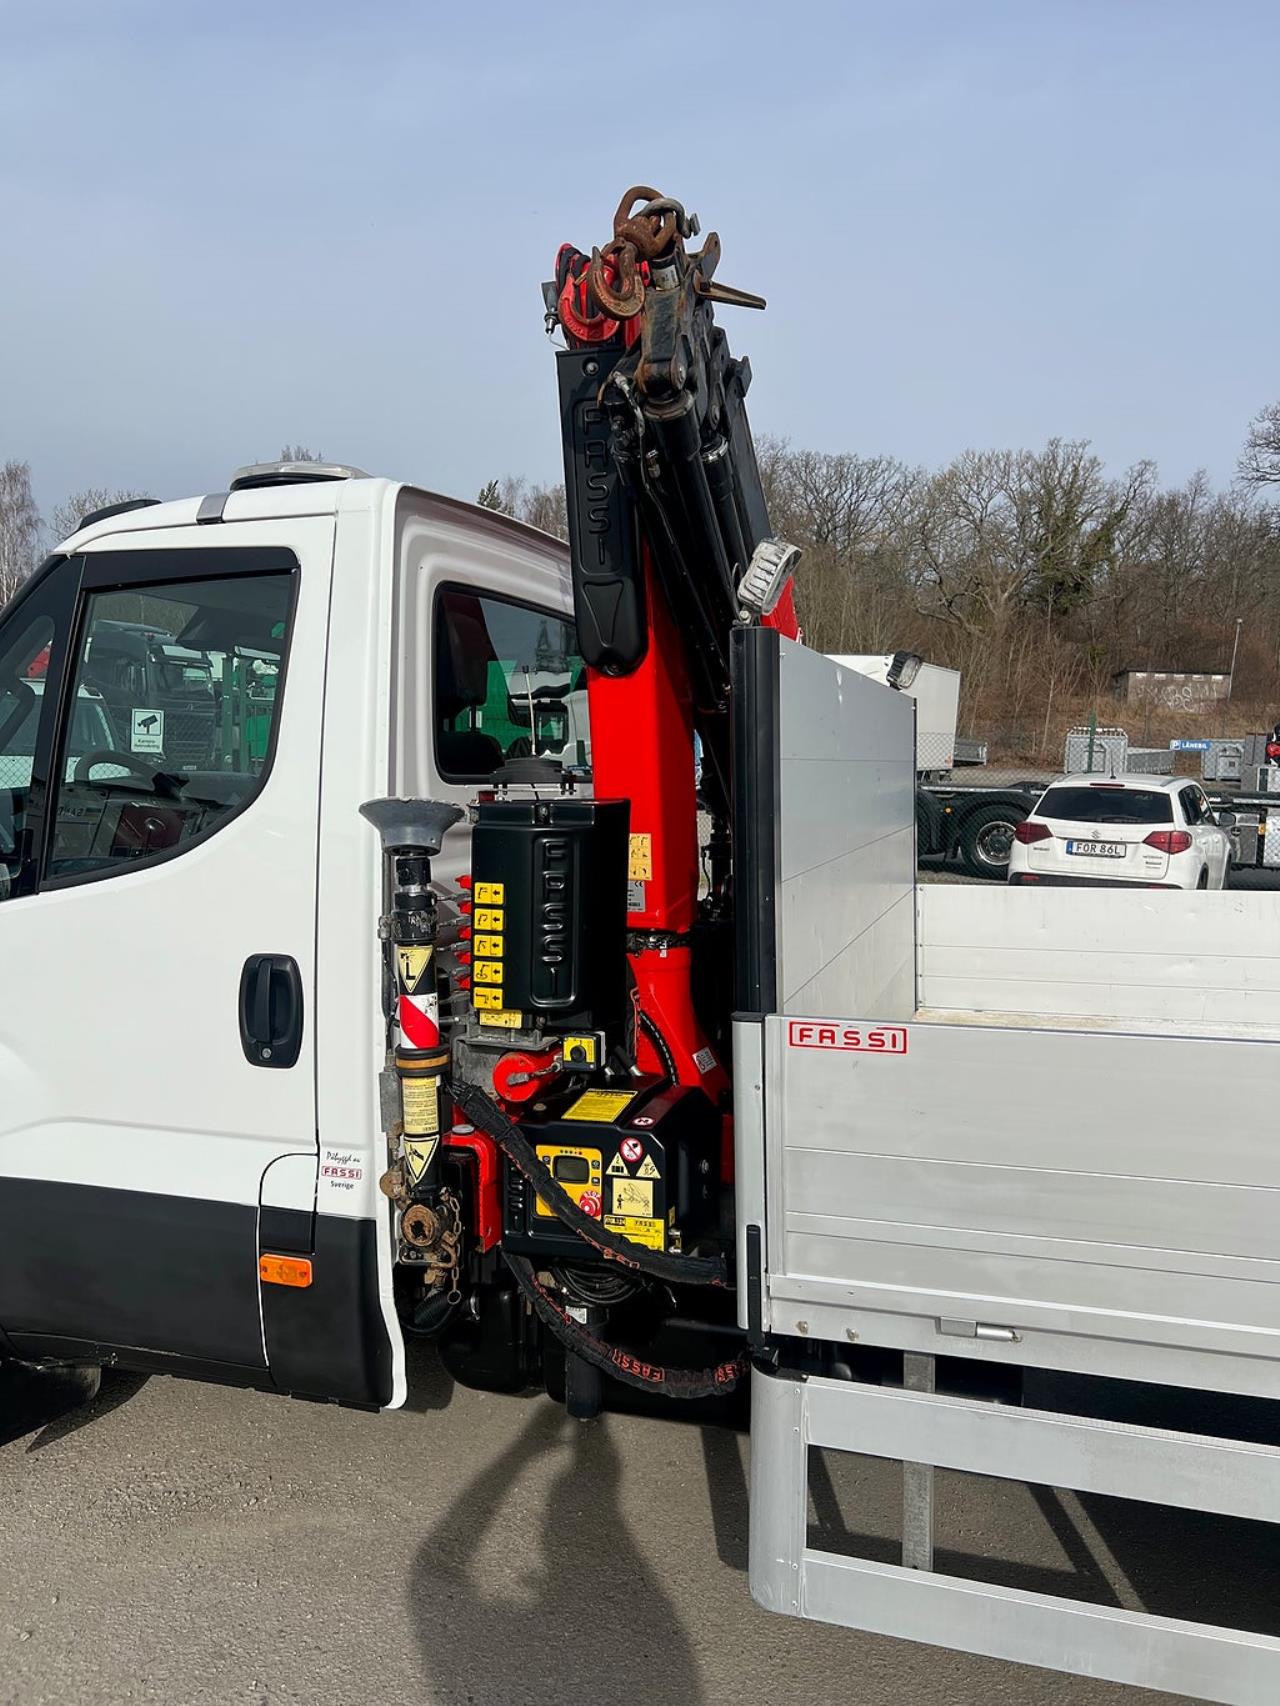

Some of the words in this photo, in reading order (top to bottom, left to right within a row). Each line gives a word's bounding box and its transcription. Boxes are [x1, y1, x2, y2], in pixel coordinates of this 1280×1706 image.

[583, 407, 611, 565] FASSI
[1076, 840, 1096, 853] FOR
[1099, 844, 1121, 855] 86L
[542, 838, 567, 999] FASSI
[799, 1028, 897, 1049] FASSI
[324, 1167, 359, 1178] FASSI
[330, 1180, 354, 1190] Sverige
[614, 1352, 663, 1382] FASSI
